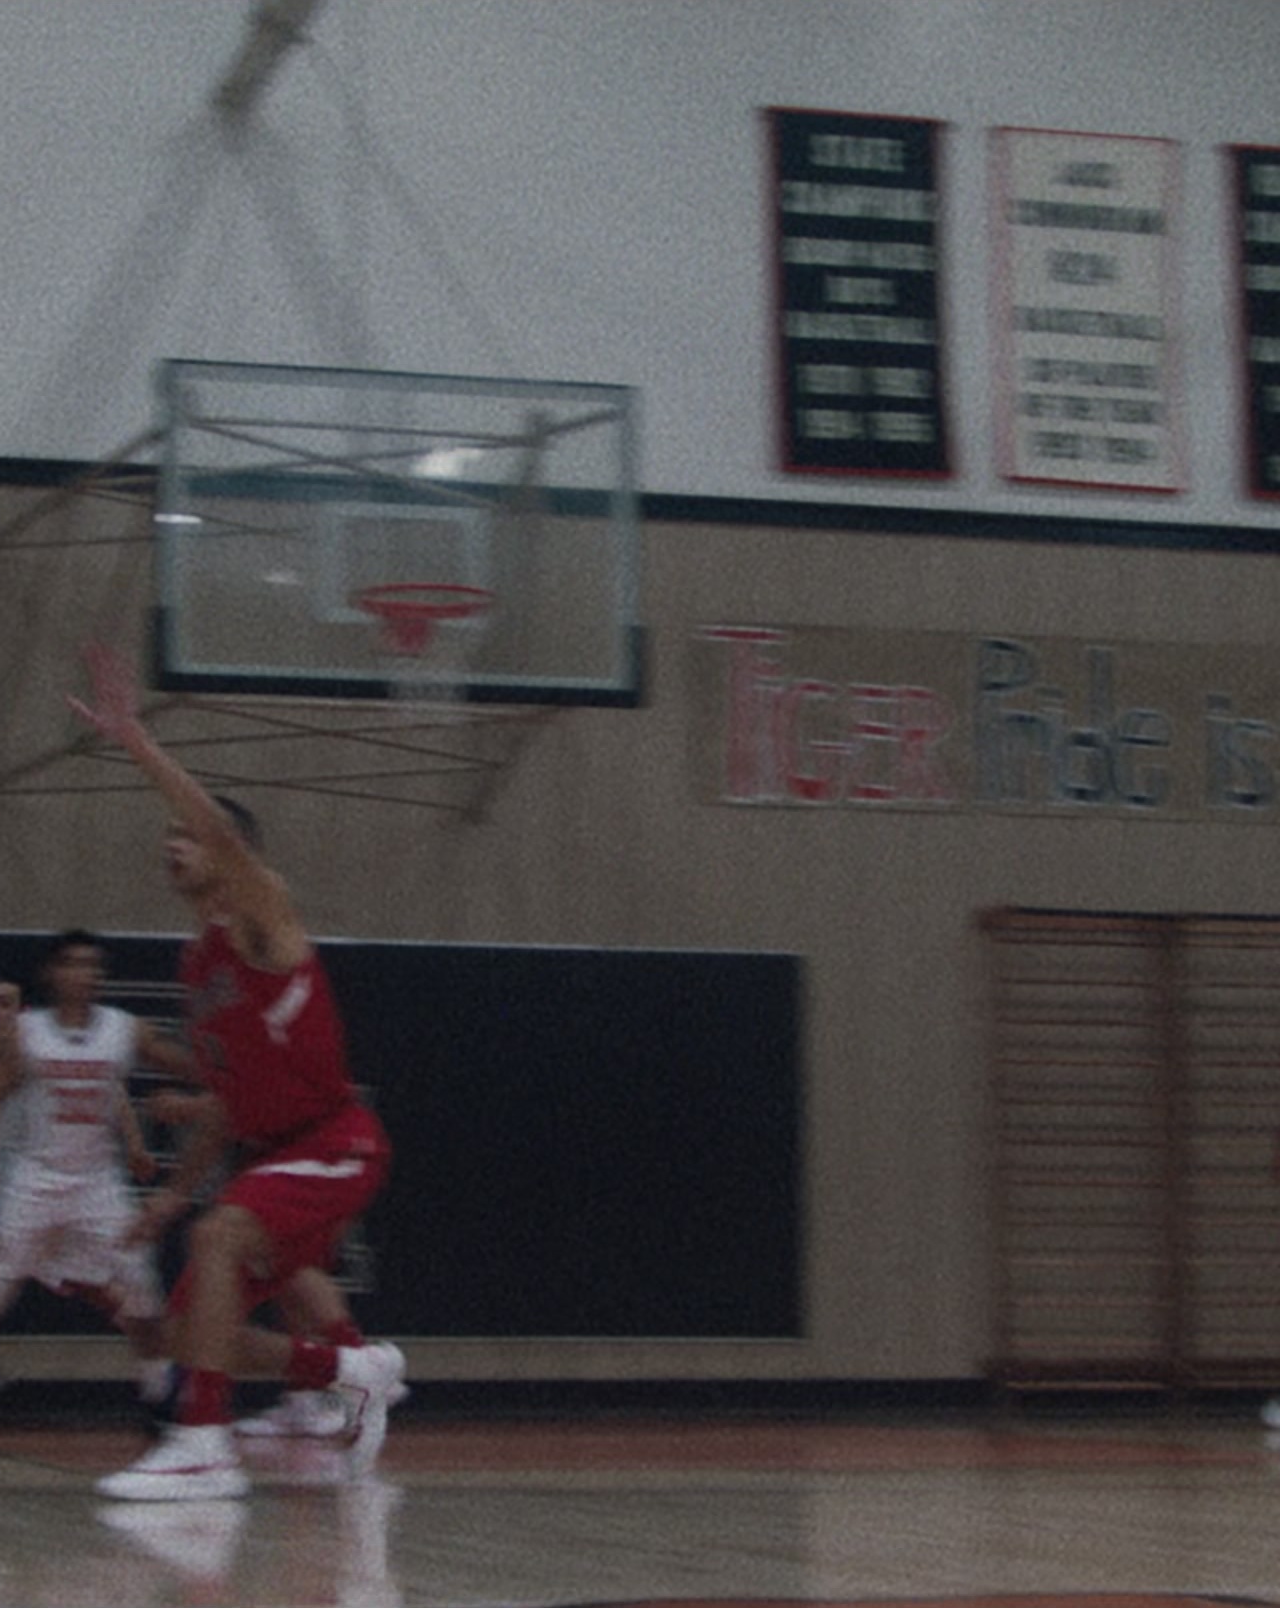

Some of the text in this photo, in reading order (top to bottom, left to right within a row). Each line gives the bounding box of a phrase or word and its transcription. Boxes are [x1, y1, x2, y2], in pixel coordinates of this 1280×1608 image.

[696, 626, 952, 804] TIGER
[972, 637, 1170, 808] Pride
[1206, 692, 1278, 808] is
